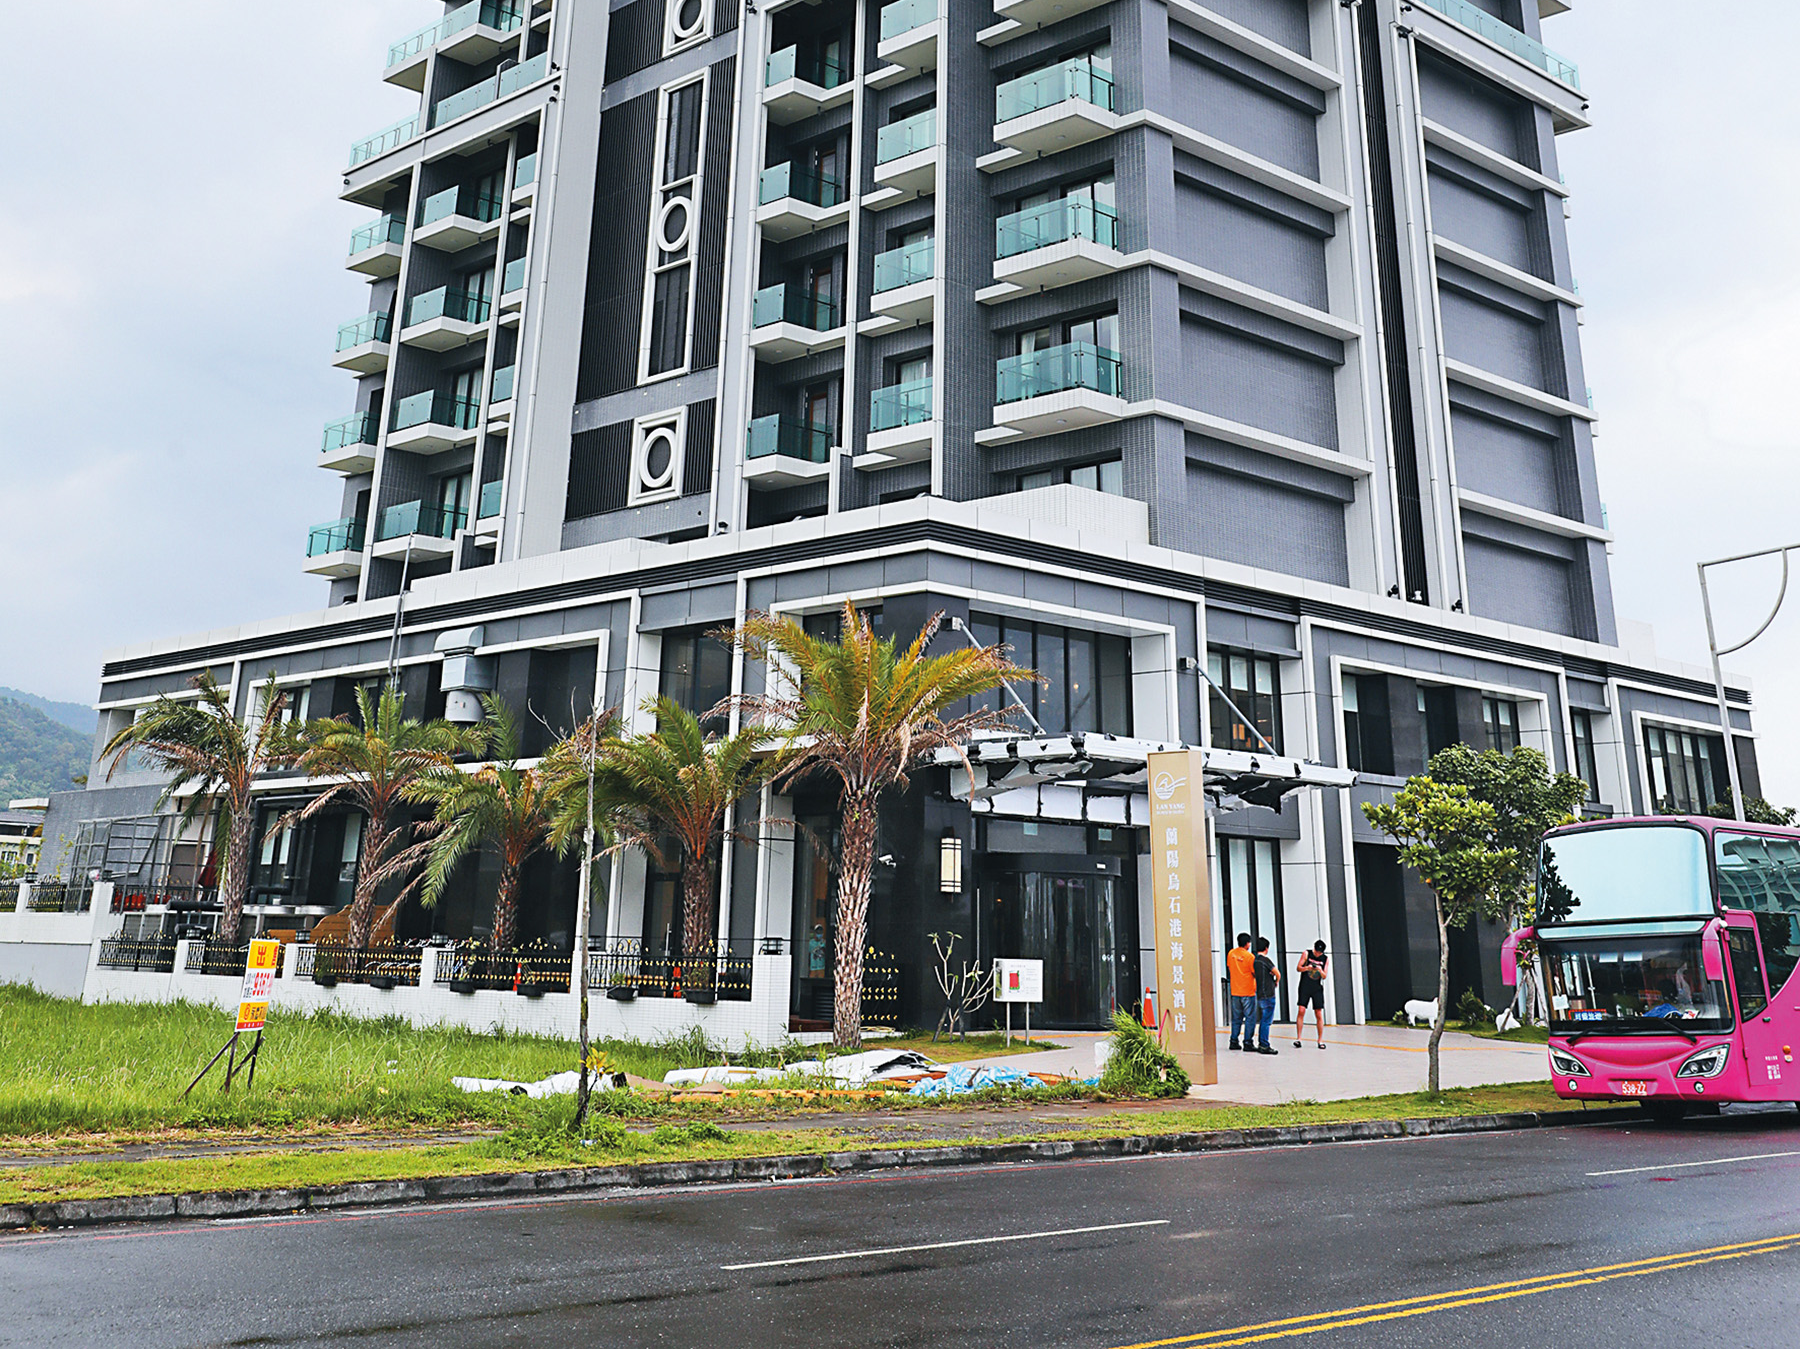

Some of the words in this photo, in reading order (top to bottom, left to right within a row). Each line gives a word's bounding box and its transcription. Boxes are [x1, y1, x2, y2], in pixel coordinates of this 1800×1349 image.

[1165, 827, 1187, 1033] 蘭陽烏石港海景酒店
